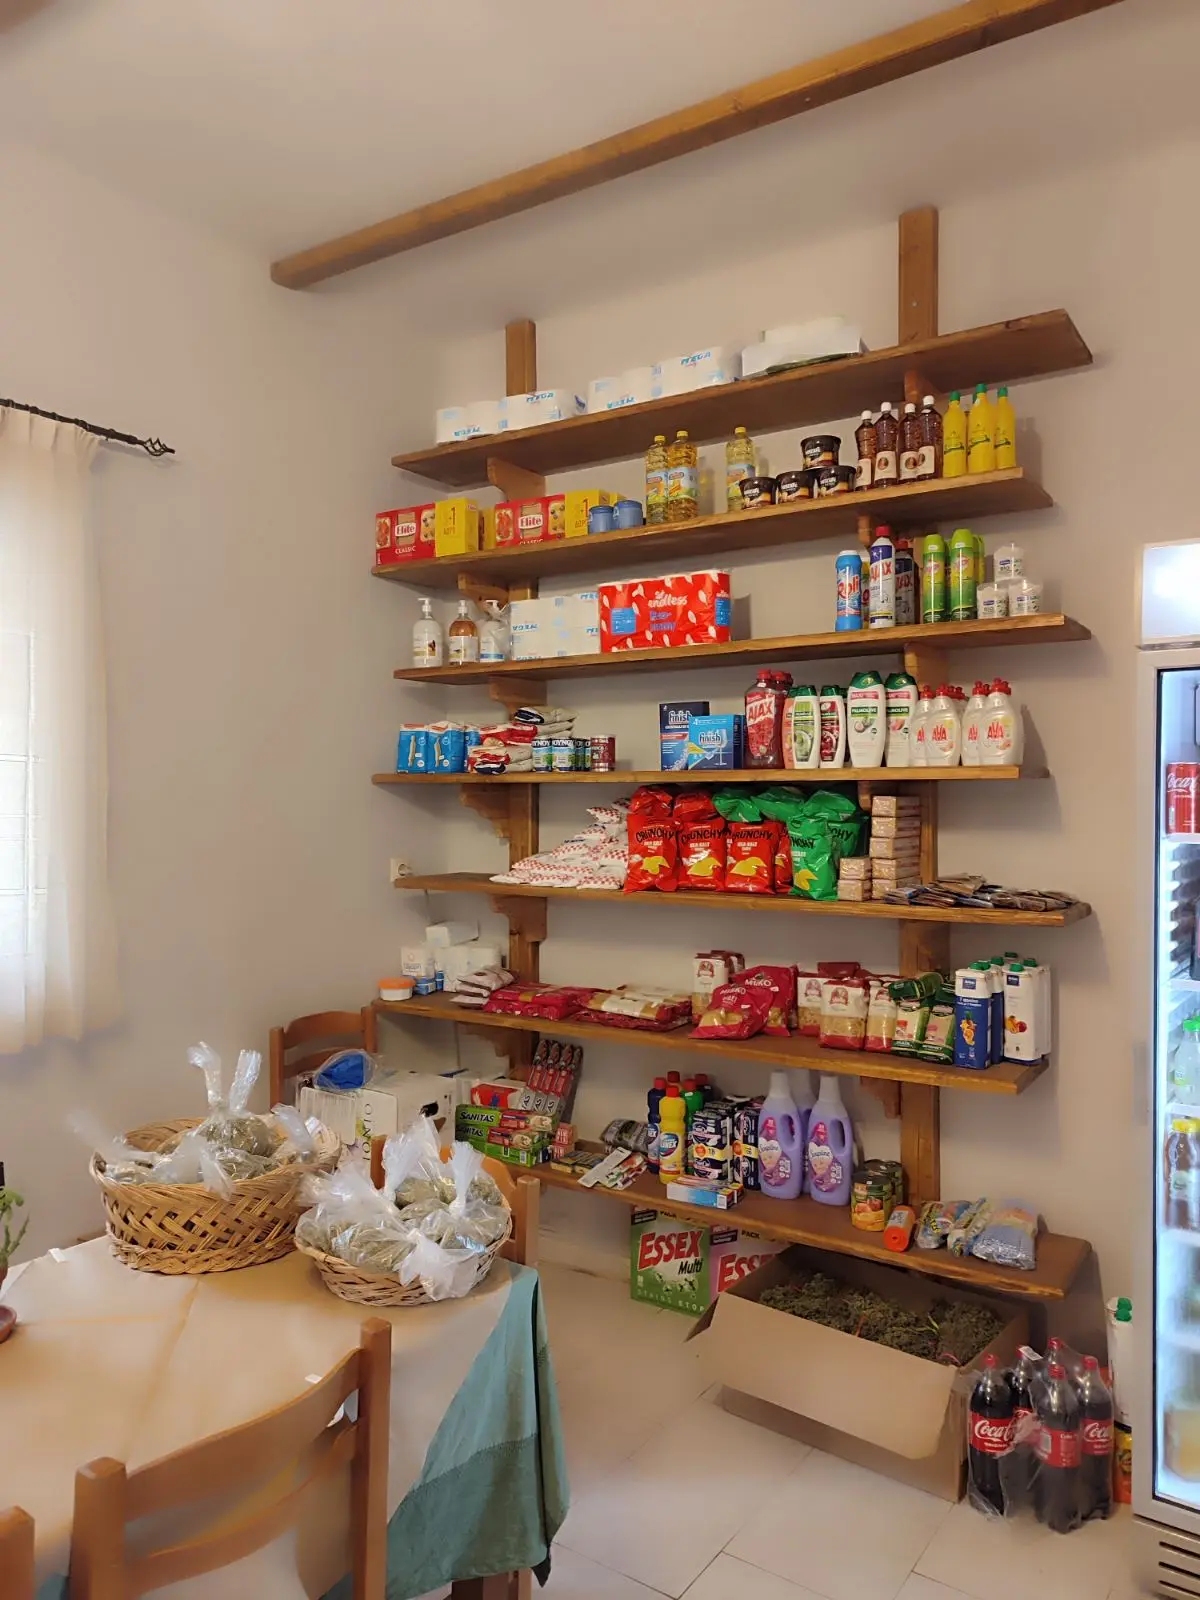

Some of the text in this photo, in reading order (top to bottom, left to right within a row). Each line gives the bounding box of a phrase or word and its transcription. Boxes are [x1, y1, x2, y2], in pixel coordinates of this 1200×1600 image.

[520, 516, 542, 528] Elite
[396, 524, 416, 535] Elite
[647, 596, 688, 608] endless
[749, 702, 774, 721] AJAX
[699, 731, 722, 744] finish
[635, 827, 677, 844] CRUNCHY
[681, 828, 723, 844] CRUNCHY
[459, 1111, 496, 1123] SANITAS
[741, 1229, 760, 1239] PACK
[638, 1231, 702, 1271] ESSEX
[678, 1258, 704, 1275] Multi
[718, 1253, 776, 1293] ESSE
